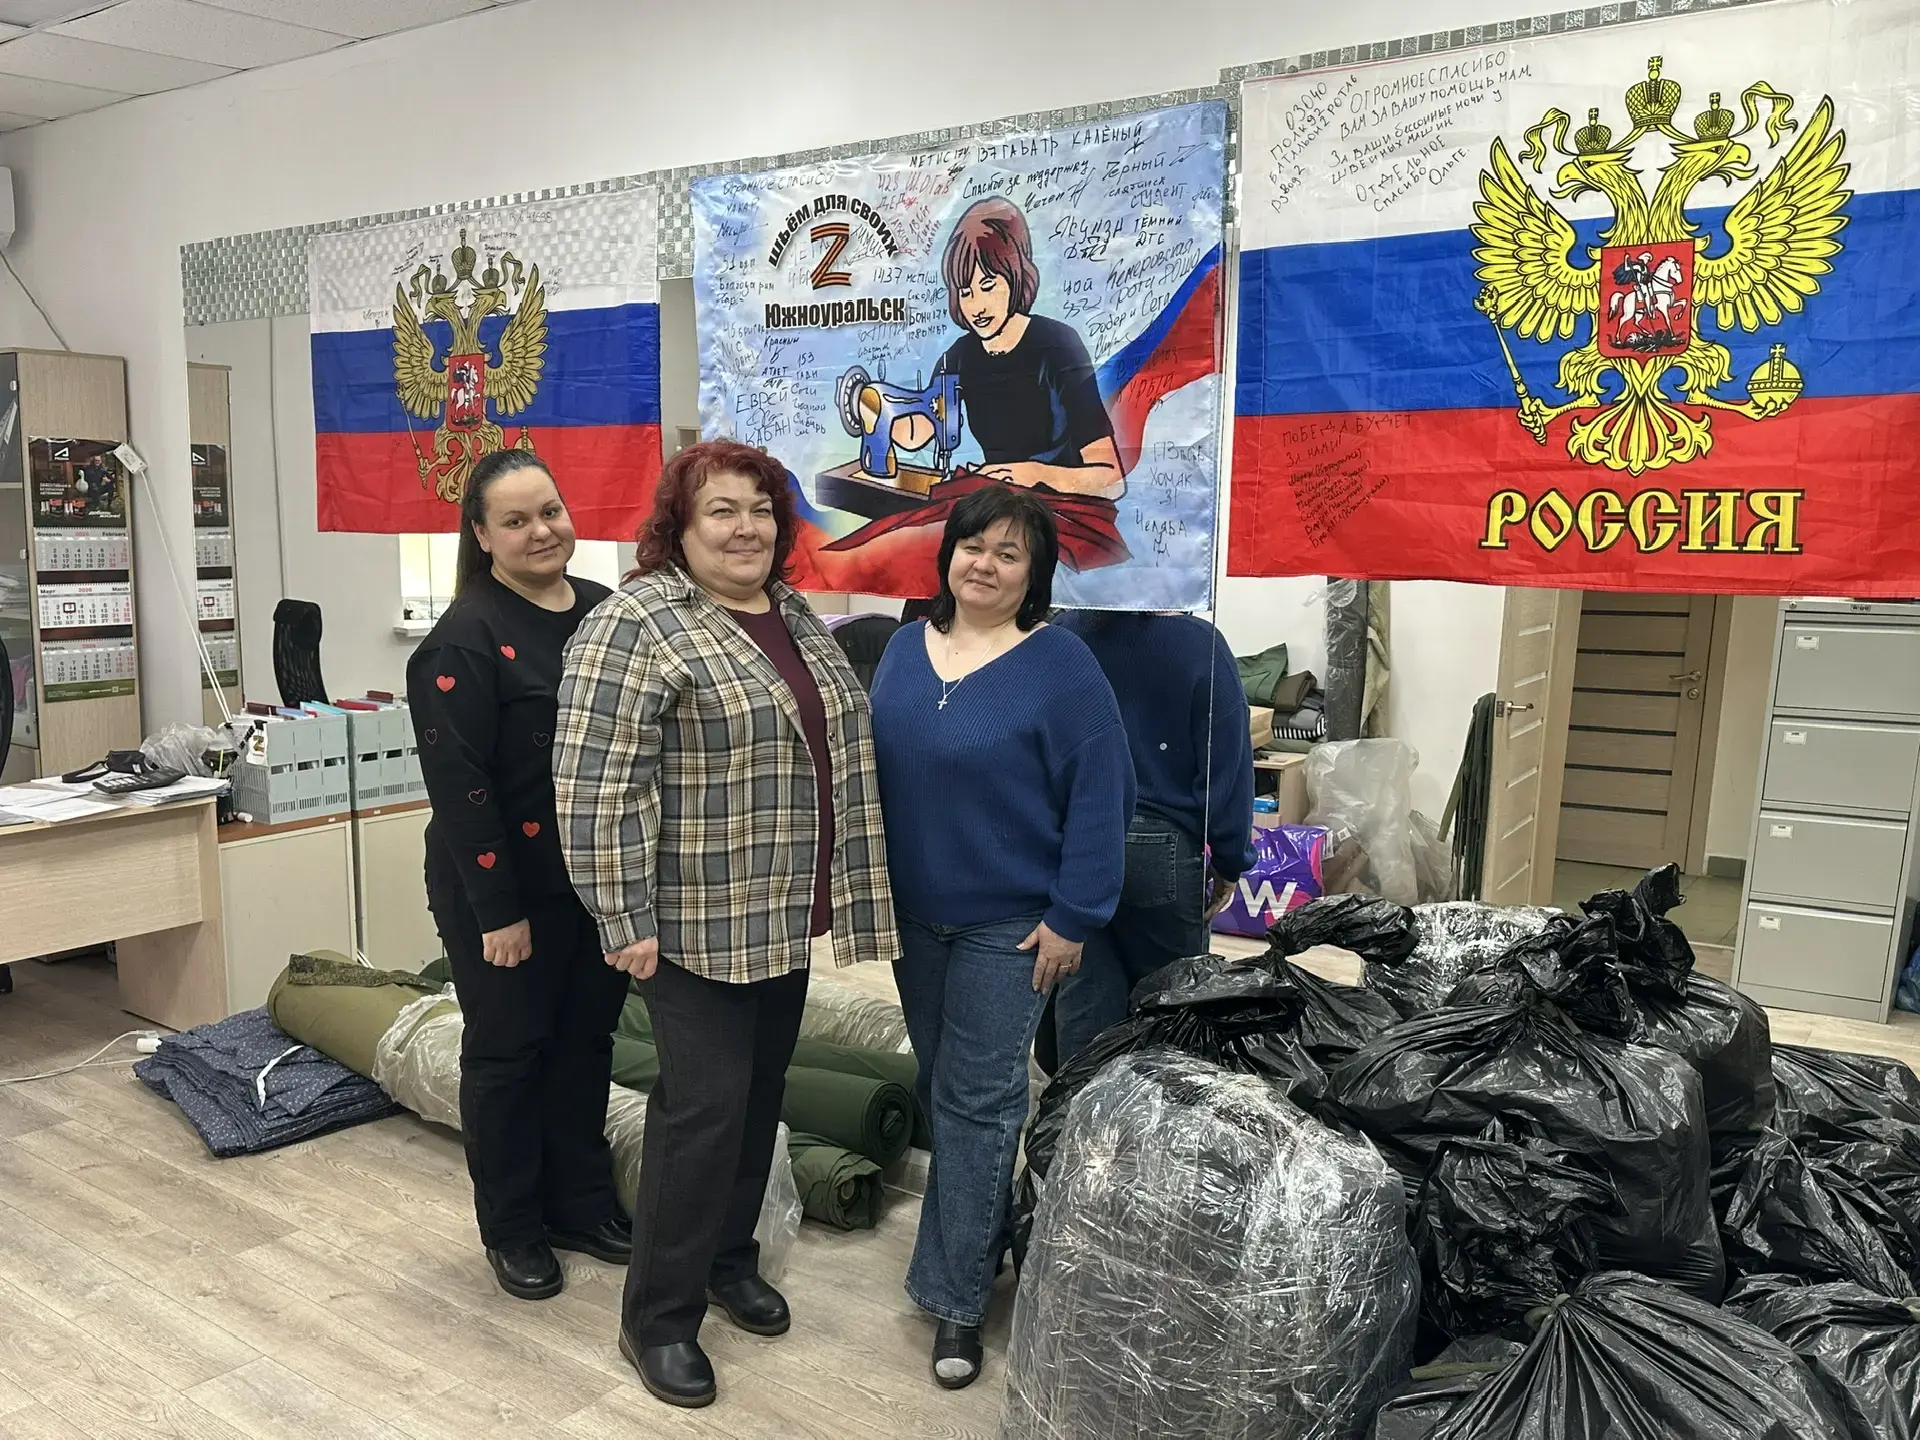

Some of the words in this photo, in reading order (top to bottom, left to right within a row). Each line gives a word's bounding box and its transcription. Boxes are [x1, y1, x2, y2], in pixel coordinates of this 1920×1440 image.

[1428, 51, 1506, 85] СПАСИБО
[1340, 115, 1367, 141] ВАМ
[1371, 106, 1388, 127] ЗА
[1391, 92, 1426, 118] ВАШУ
[1430, 76, 1495, 102] ПОМОЩЬ
[765, 297, 906, 329] Южноуральск
[1282, 419, 1349, 448] ПОБЕДА
[1355, 413, 1412, 434] БУДЕТ
[1479, 489, 1805, 554] РОССИЯ
[1238, 877, 1298, 920] W
